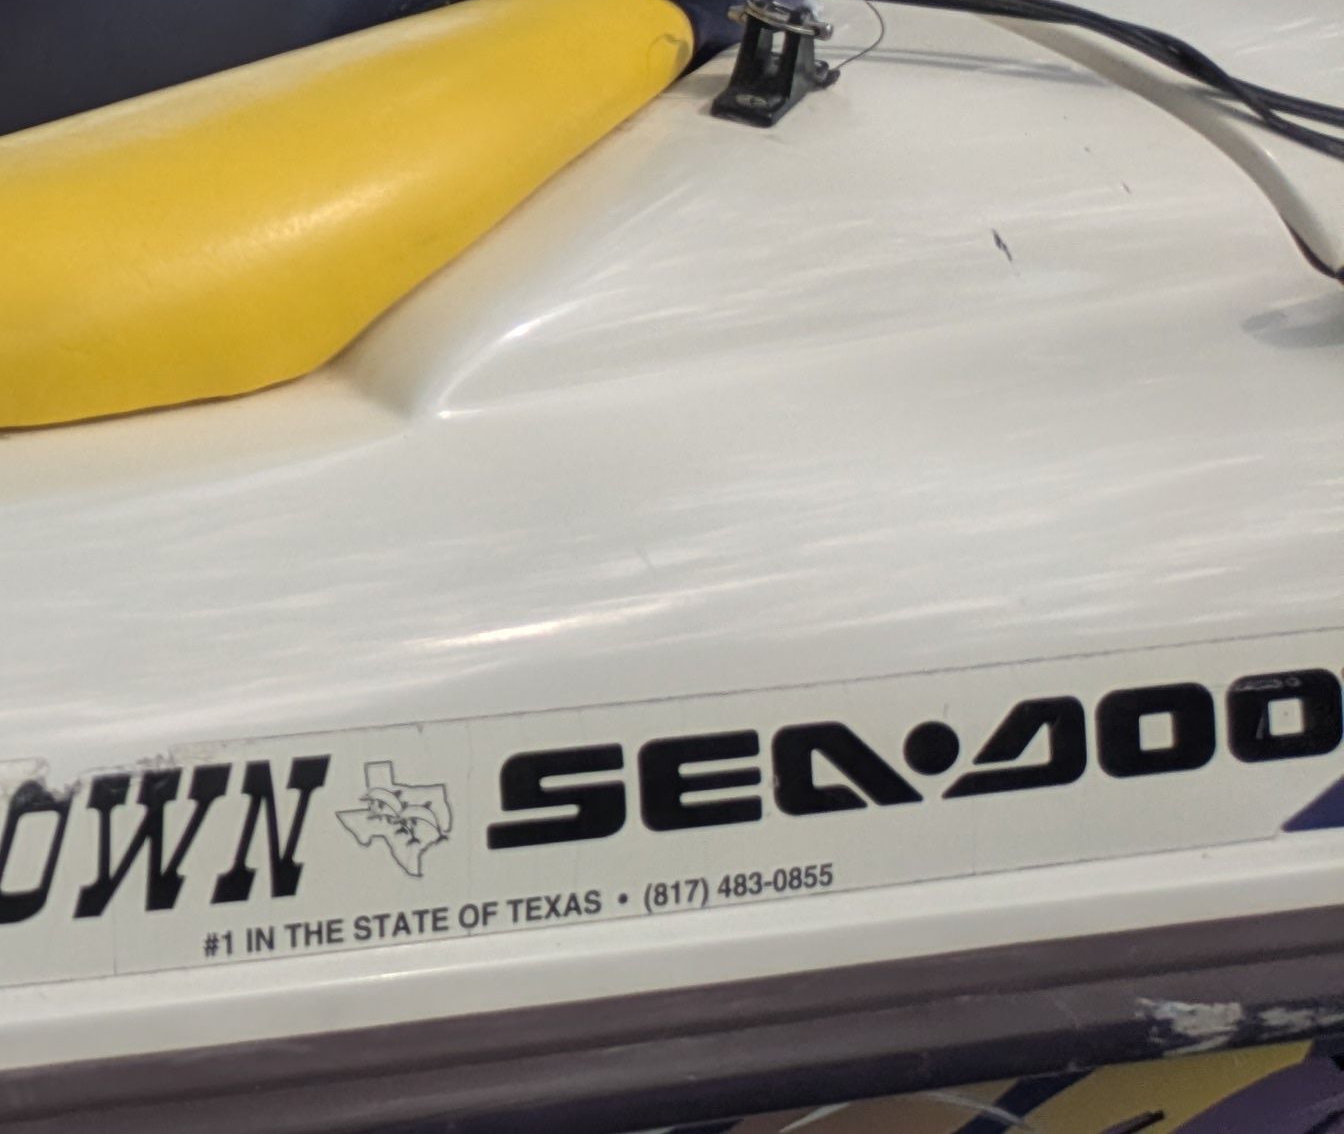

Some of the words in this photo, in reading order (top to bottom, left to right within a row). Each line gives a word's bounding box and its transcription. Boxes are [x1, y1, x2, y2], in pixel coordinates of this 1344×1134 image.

[203, 931, 234, 956] #1
[246, 926, 275, 953] IN
[285, 919, 344, 949] THE
[353, 907, 450, 941] STATE
[458, 901, 499, 929] OF
[507, 889, 603, 923] TEXAS
[643, 877, 710, 915] (817)
[717, 862, 834, 898] 483-0855
